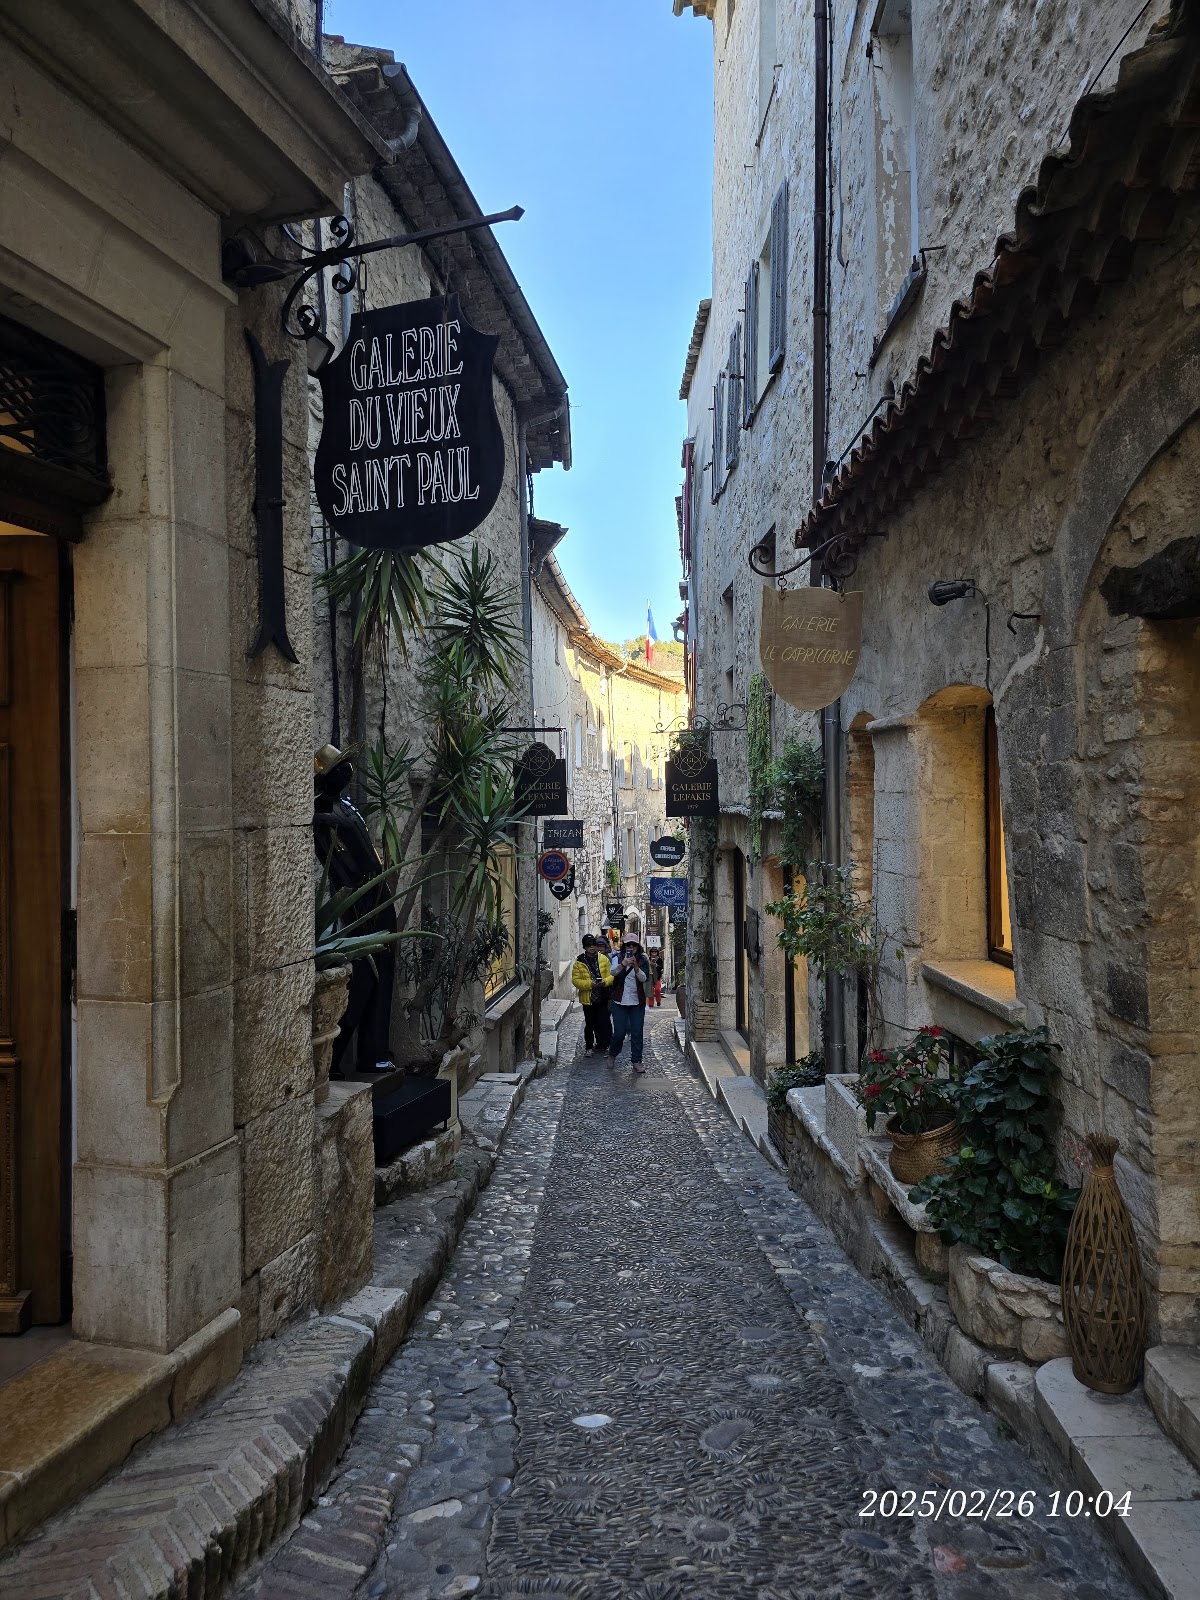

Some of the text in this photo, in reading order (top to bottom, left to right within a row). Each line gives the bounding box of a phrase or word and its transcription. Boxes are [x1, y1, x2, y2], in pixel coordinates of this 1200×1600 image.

[351, 320, 463, 391] GALERIE
[350, 384, 460, 450] DU VIEUX
[332, 447, 480, 516] SAINT PAUL
[781, 616, 840, 633] GALERIE
[764, 645, 857, 665] LE CAPRICORNE
[671, 782, 712, 791] GALERIE
[673, 792, 711, 802] LEFAKIS
[547, 828, 582, 838] TRIZAN
